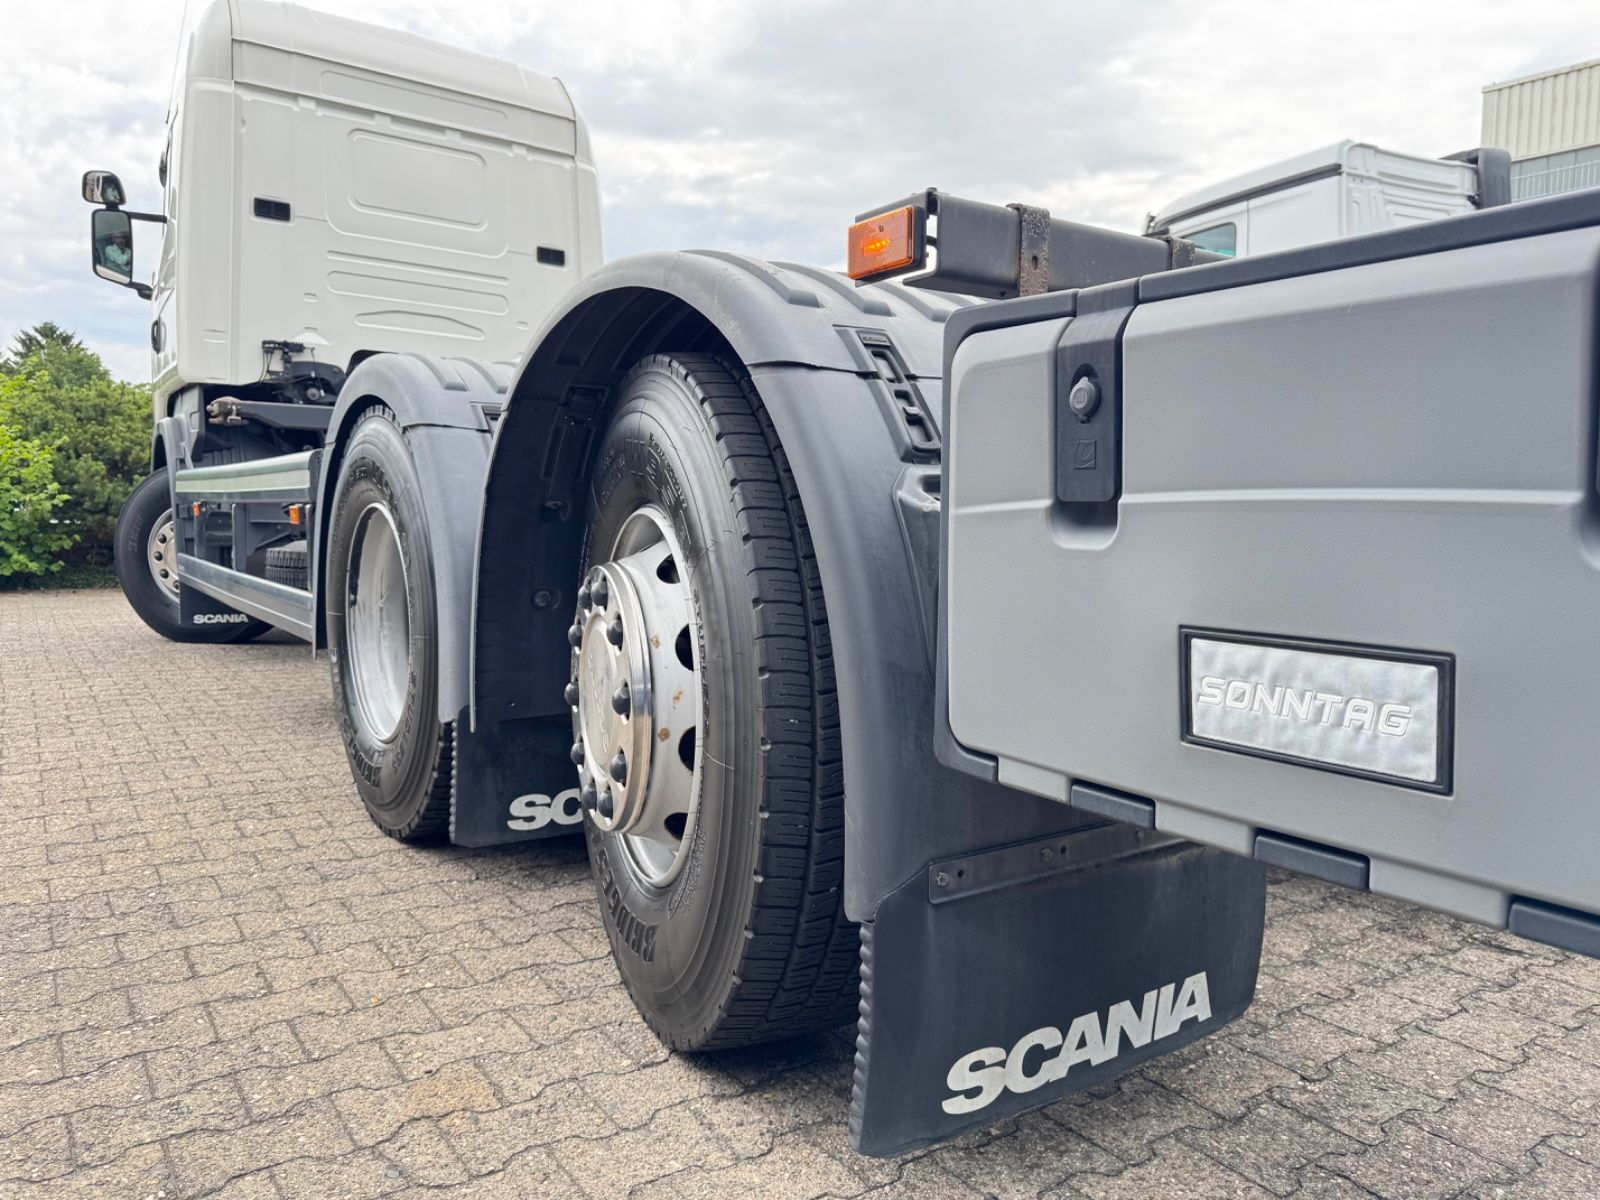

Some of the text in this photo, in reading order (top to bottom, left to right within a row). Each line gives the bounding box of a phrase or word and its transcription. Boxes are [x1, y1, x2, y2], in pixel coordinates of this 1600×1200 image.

[193, 613, 249, 624] SCANIA
[1197, 675, 1413, 737] SONNTAG
[941, 971, 1212, 1115] SCANIA
